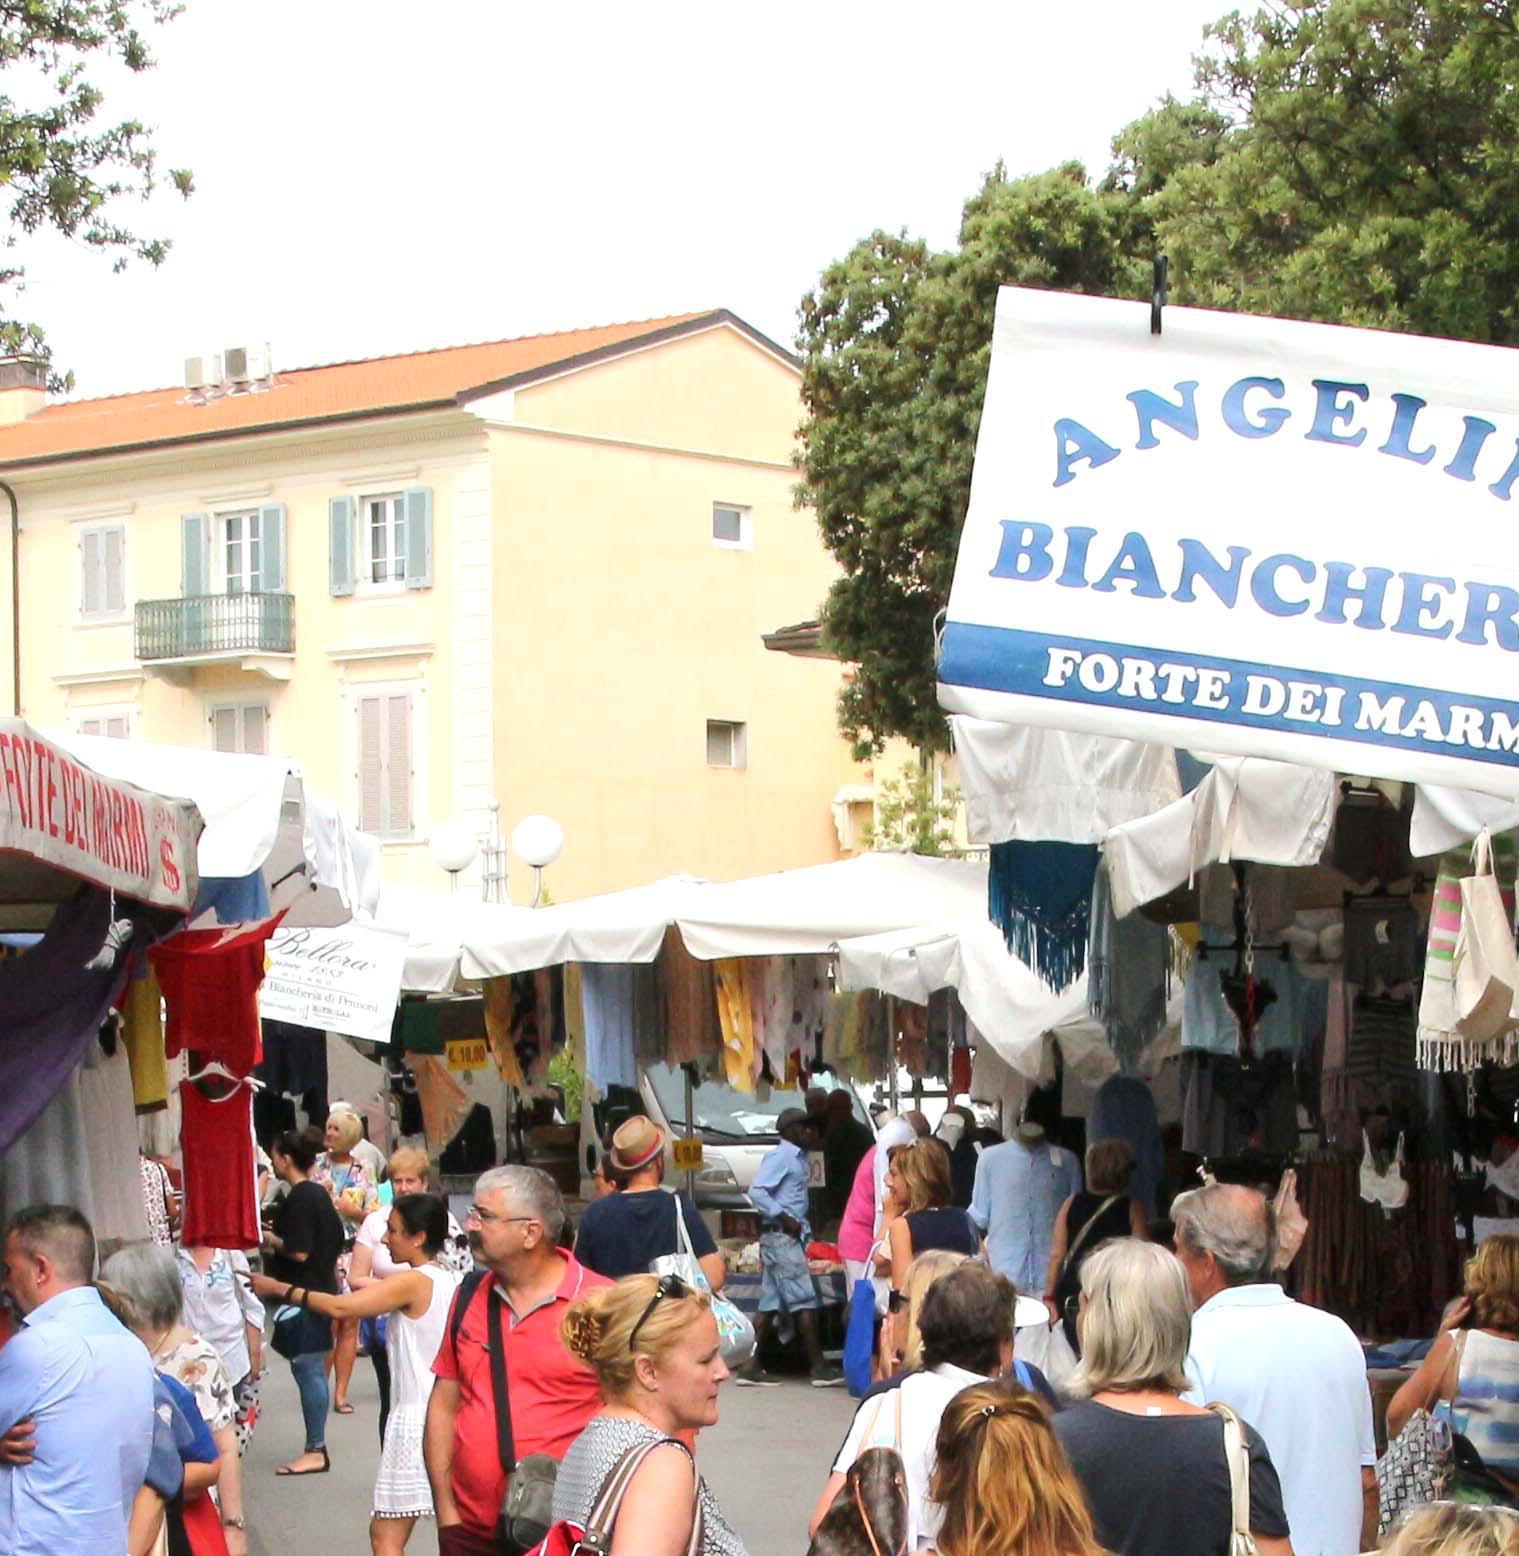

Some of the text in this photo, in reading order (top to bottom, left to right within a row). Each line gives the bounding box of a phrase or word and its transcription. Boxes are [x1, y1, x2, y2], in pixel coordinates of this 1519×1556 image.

[1042, 646, 1232, 712] FORTE
[1240, 674, 1347, 729] DEI
[60, 757, 90, 854] DEI
[268, 926, 369, 971] Bellora
